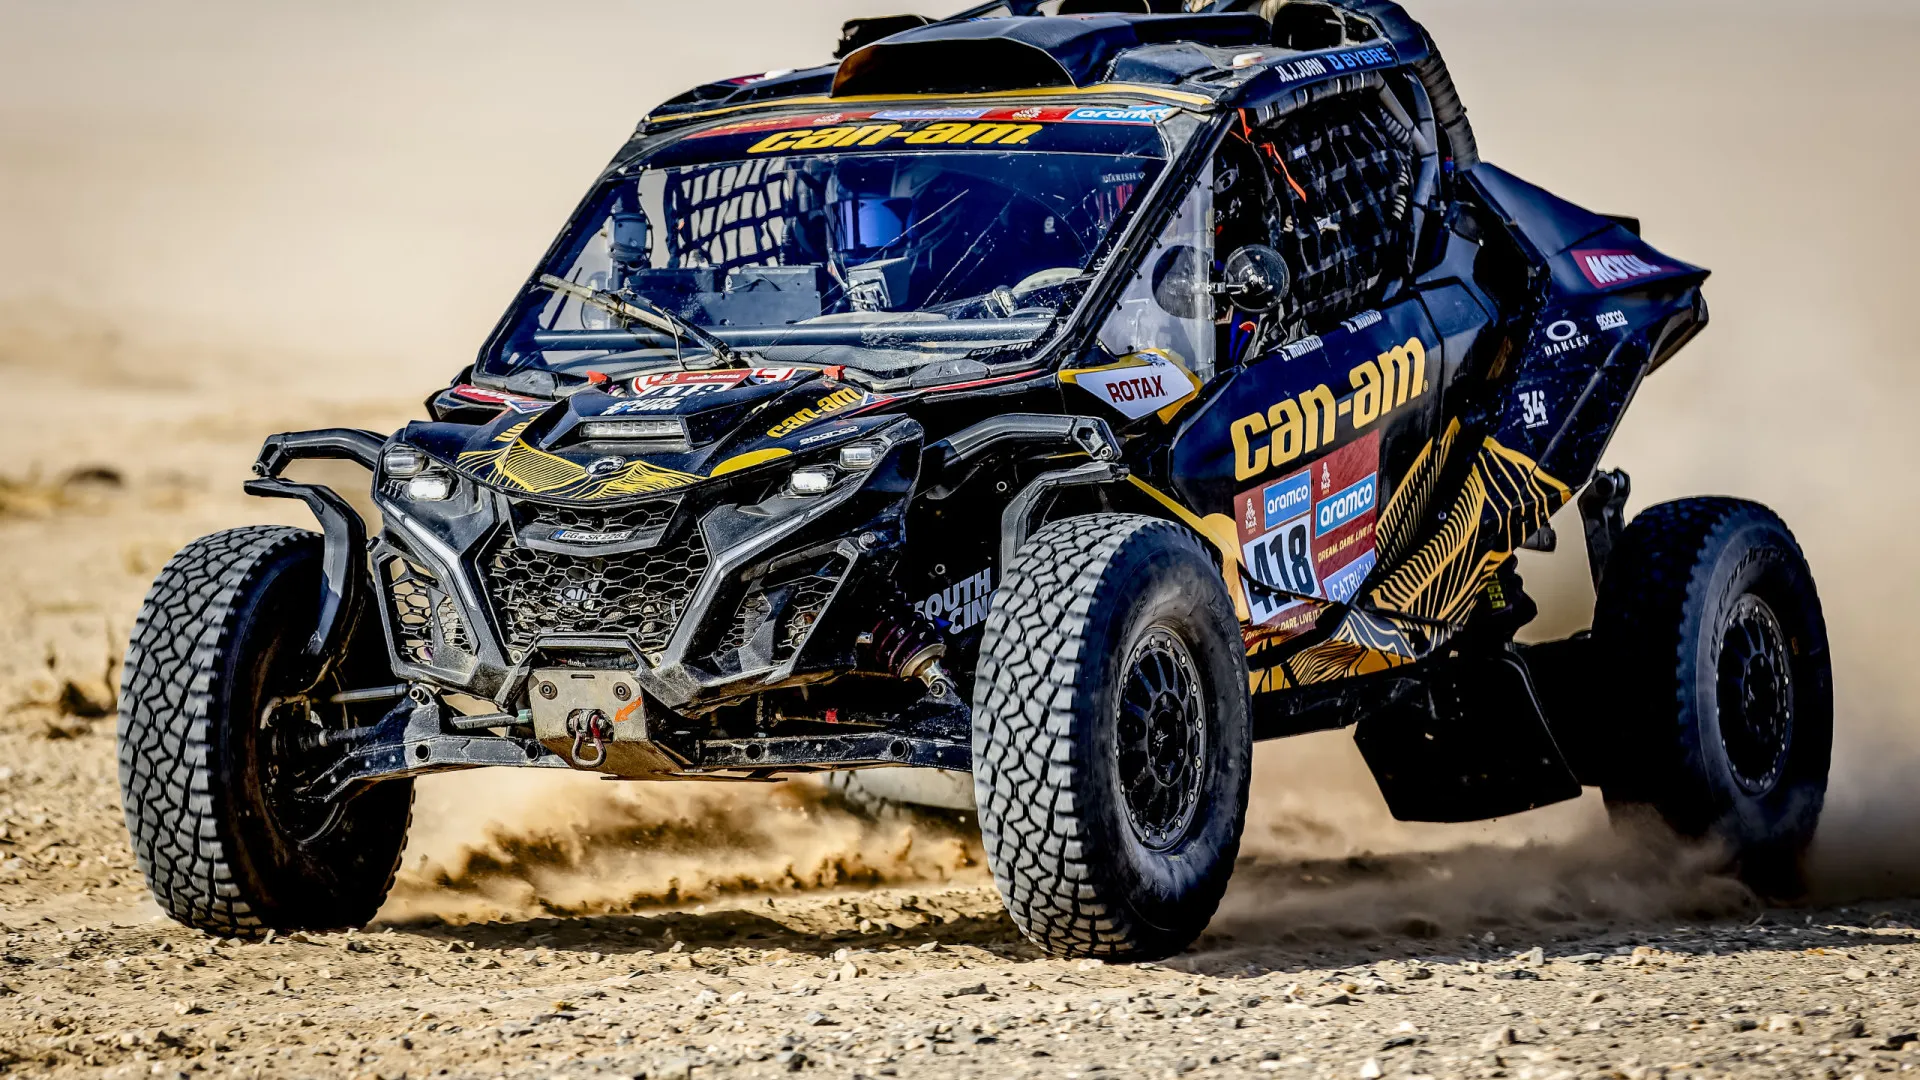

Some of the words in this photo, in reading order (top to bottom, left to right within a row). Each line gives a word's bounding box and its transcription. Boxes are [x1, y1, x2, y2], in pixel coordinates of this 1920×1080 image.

[747, 122, 1043, 154] can-am
[1544, 334, 1590, 357] OAKLEY
[1105, 375, 1166, 403] ROTAX
[766, 387, 863, 438] can-am
[799, 425, 859, 446] sparco
[1267, 484, 1309, 515] aramco
[1319, 482, 1373, 528] aramco
[1250, 523, 1316, 616] 418
